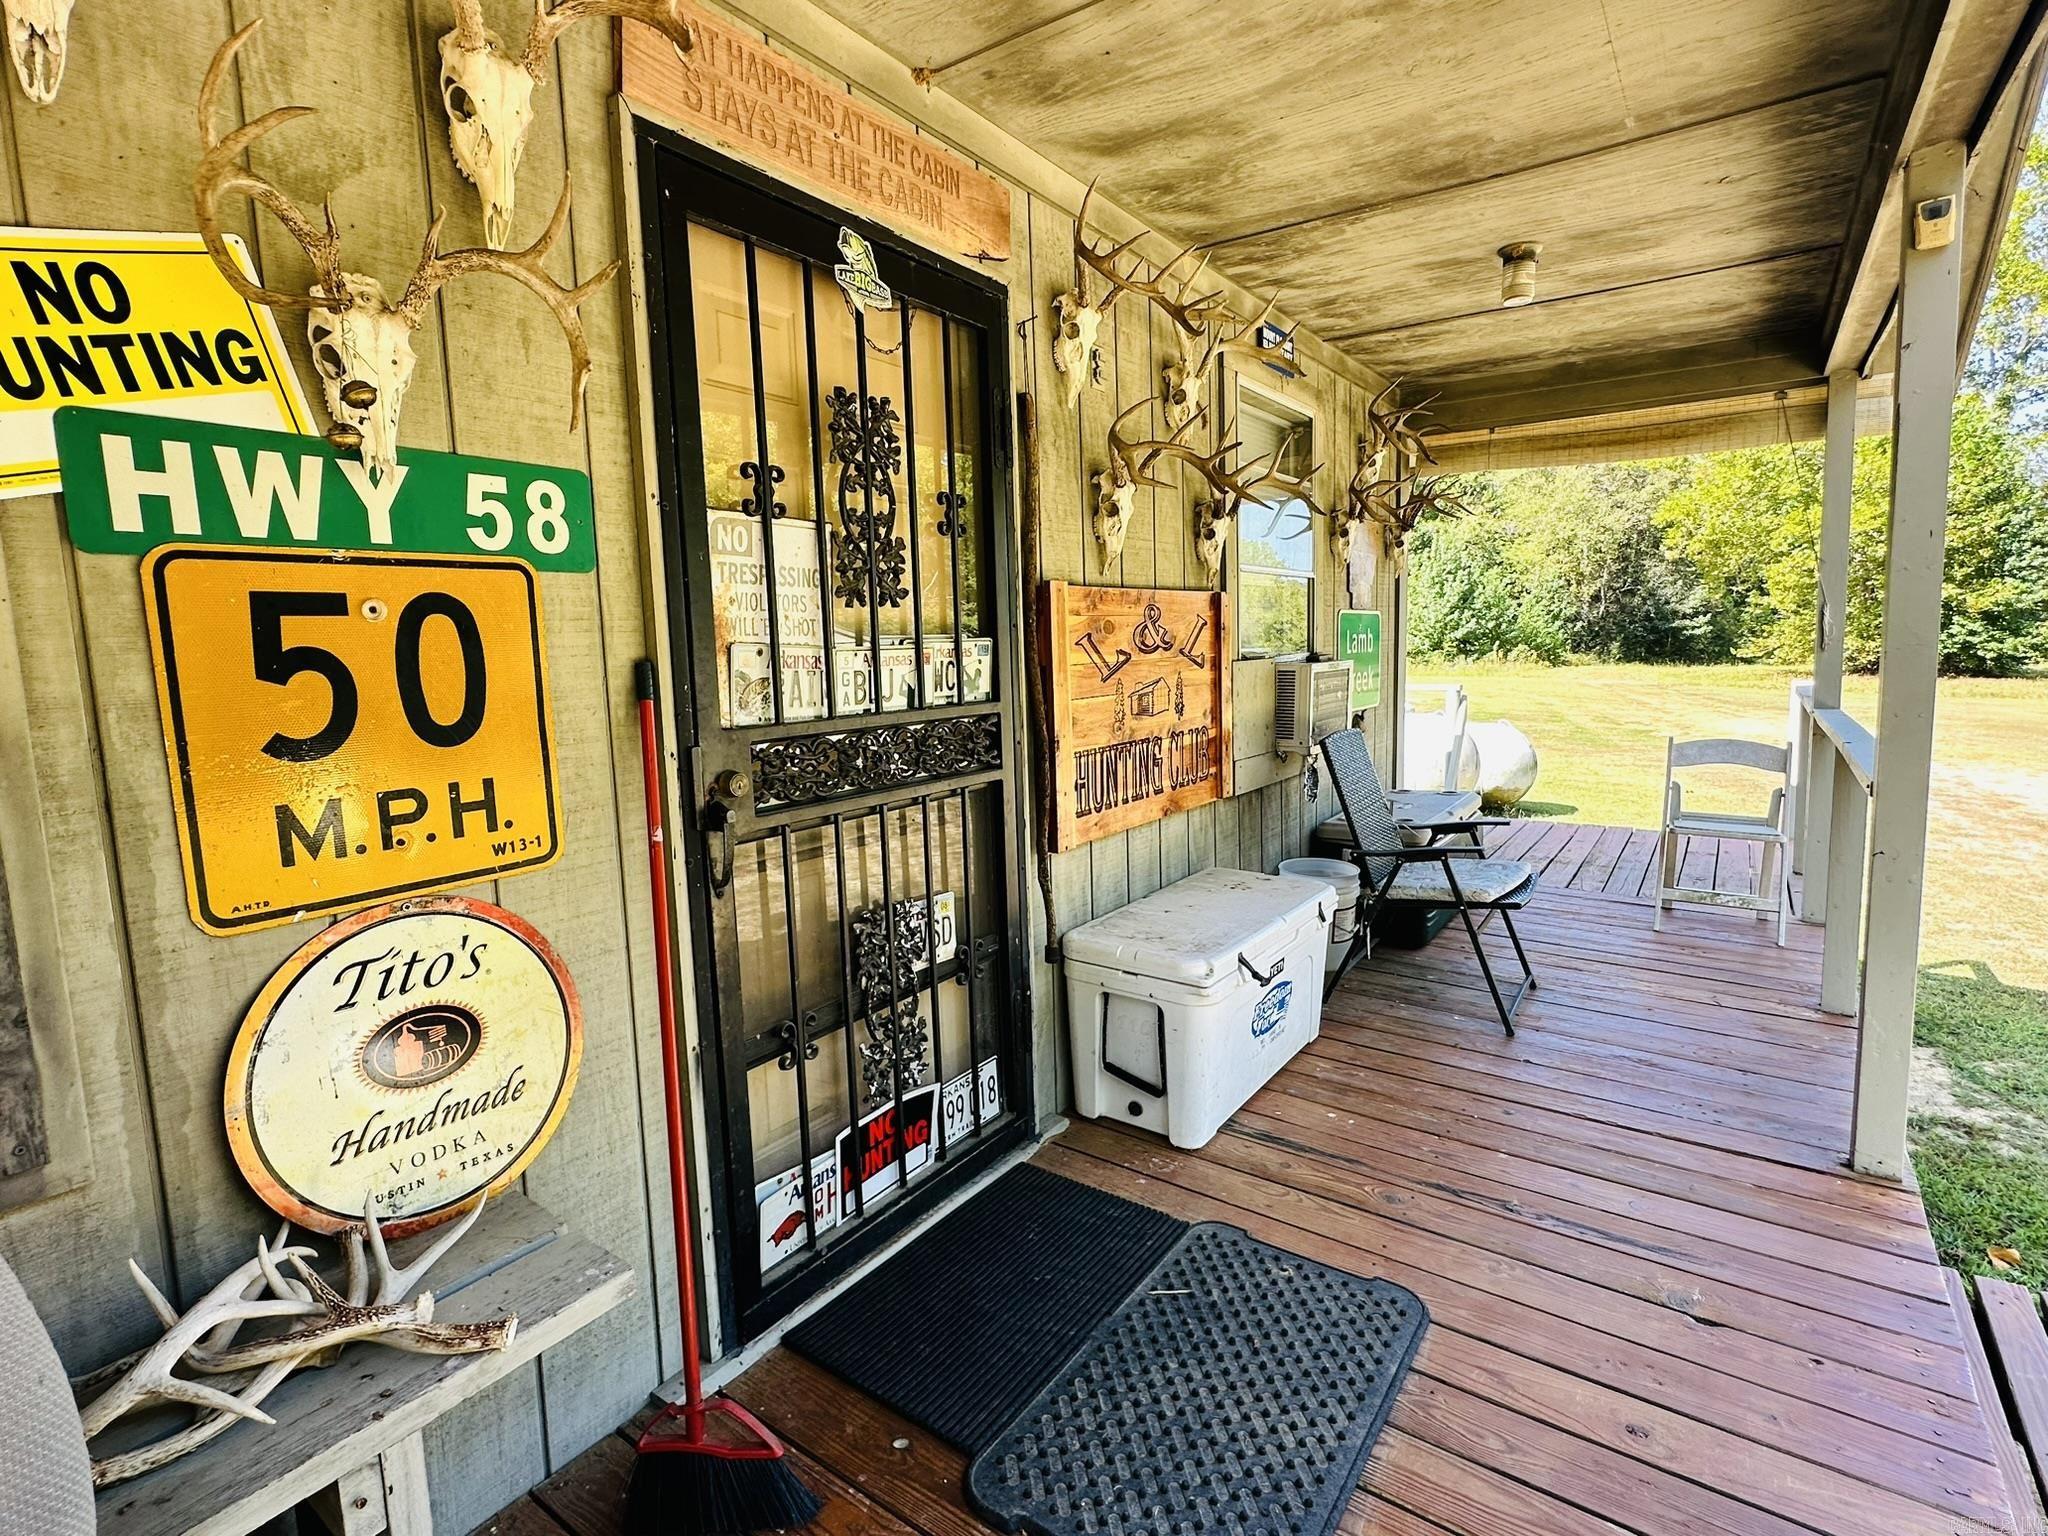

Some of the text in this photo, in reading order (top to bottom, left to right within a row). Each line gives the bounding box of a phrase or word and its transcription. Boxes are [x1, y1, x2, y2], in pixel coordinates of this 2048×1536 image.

[682, 67, 944, 232] STAYS AT THE CABIN
[727, 38, 836, 130] HAPPENS
[840, 106, 865, 143] AT
[870, 121, 906, 169] THE
[910, 144, 961, 200] CABIN
[10, 261, 131, 325] NO
[854, 272, 872, 293] BIG
[0, 328, 267, 400] UNTING
[100, 433, 570, 555] HWY 58
[717, 523, 749, 553] NO
[717, 561, 820, 589] TRESPSSING
[735, 592, 807, 613] VIOLTORS
[785, 618, 816, 637] SHOT
[1074, 603, 1208, 683] L & L
[1346, 628, 1373, 654] Lamb
[249, 591, 487, 762] 50
[1352, 666, 1374, 692] reek
[1075, 725, 1211, 818] HUNTING CLUB
[276, 778, 512, 867] M.P.H.
[491, 835, 542, 858] W13-1
[332, 935, 488, 1013] Tito's
[330, 1065, 526, 1167] Handmade
[374, 1143, 515, 1204] USTIN TEXAS
[389, 1130, 486, 1176] VODKA
